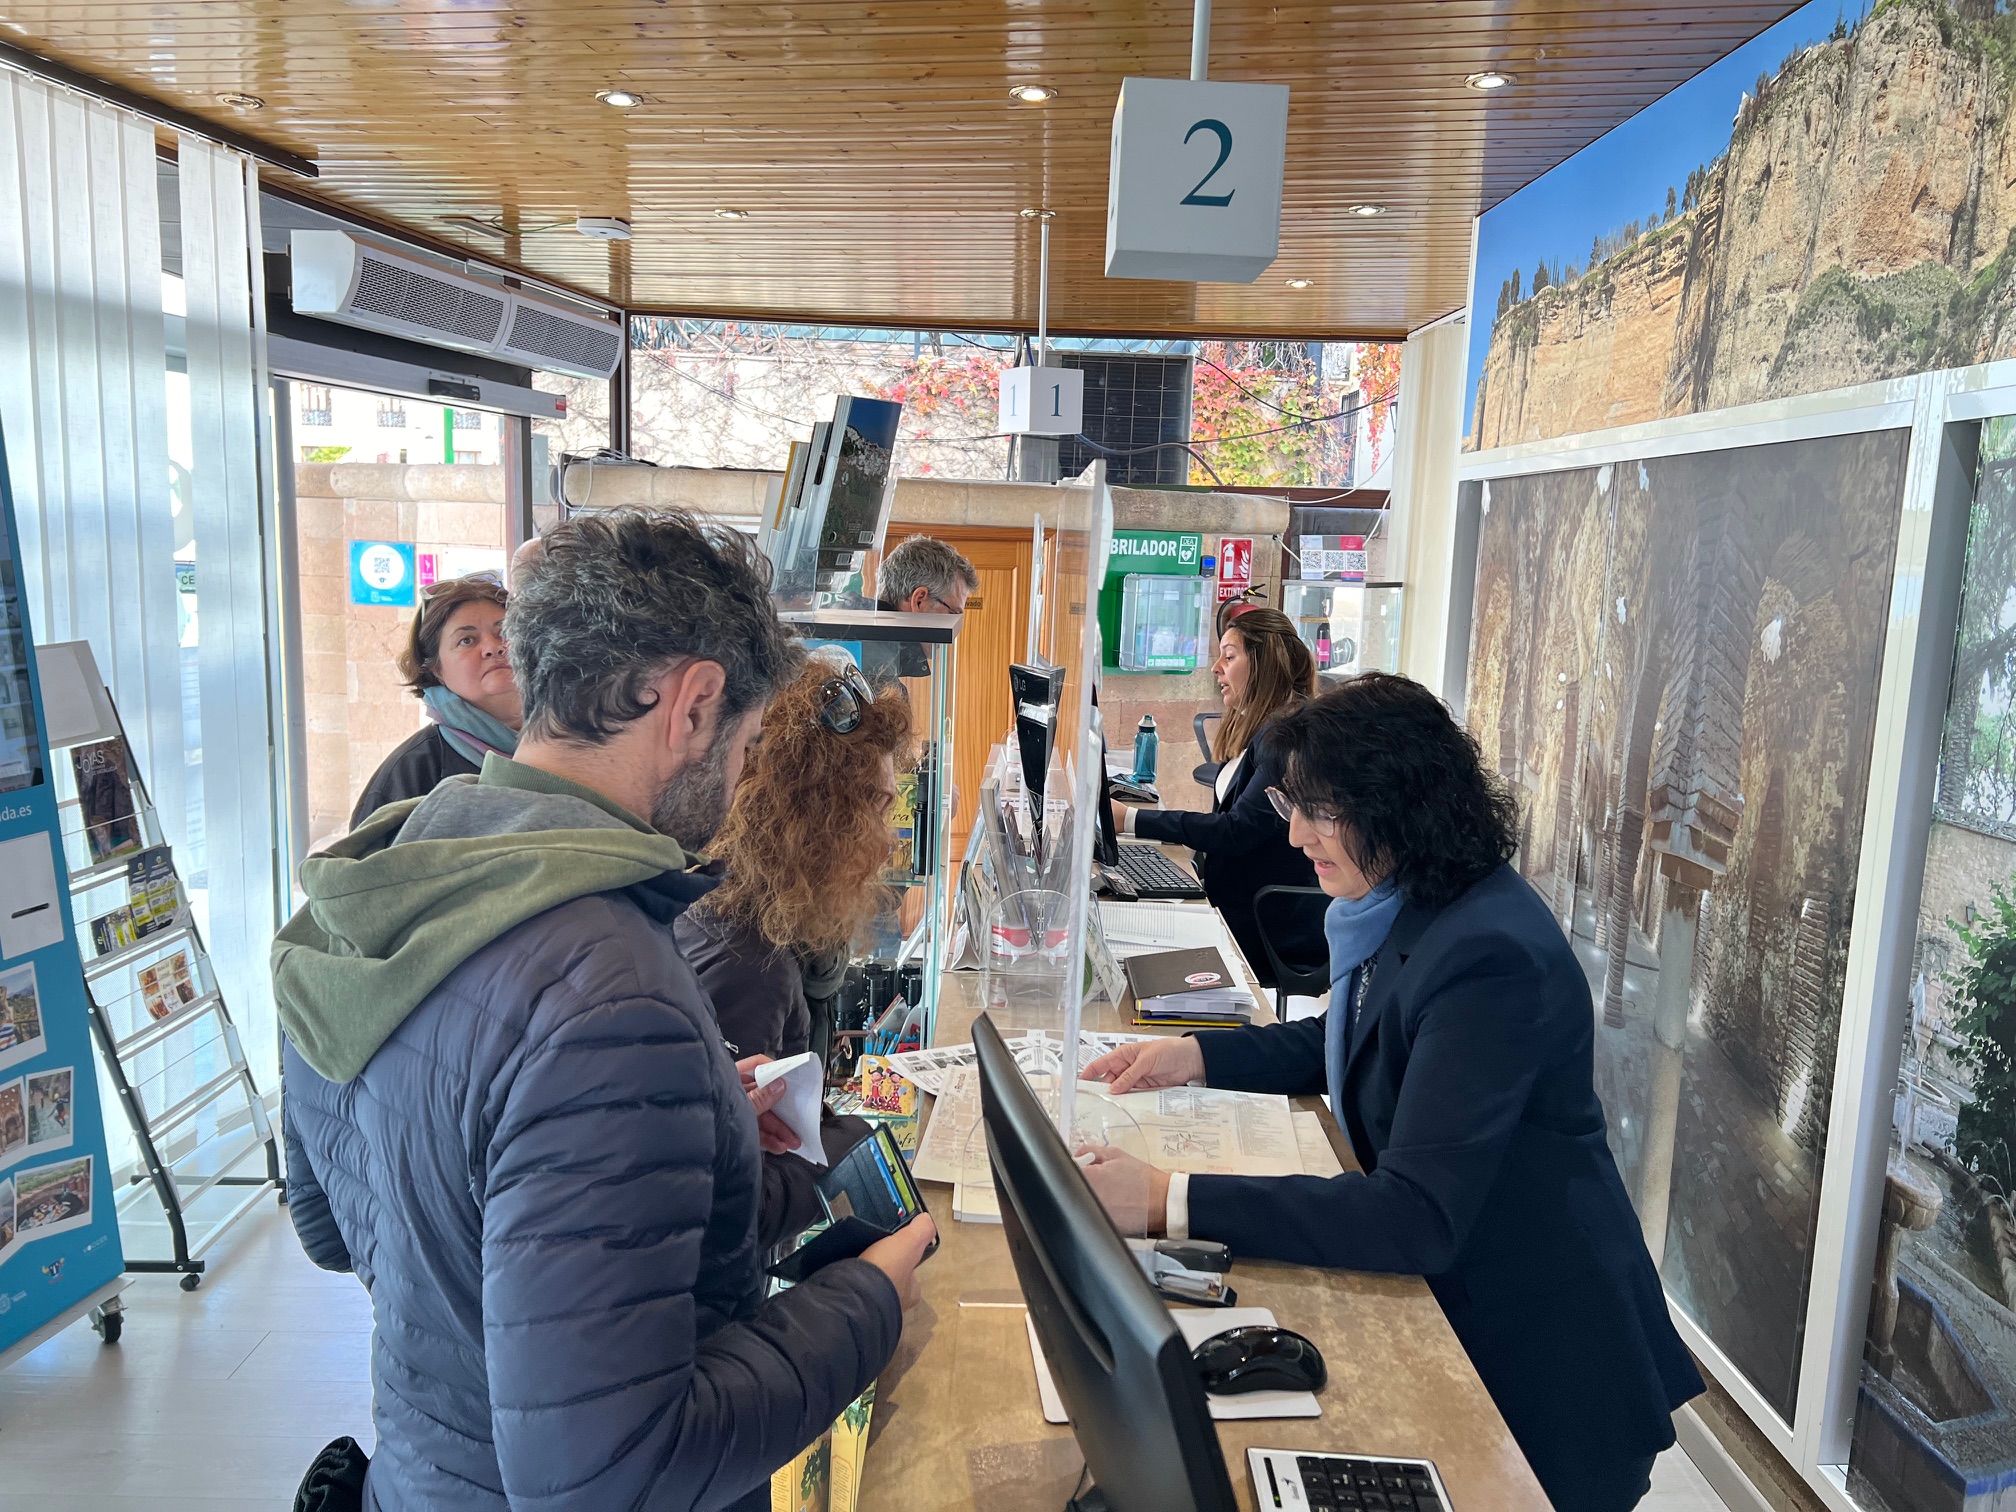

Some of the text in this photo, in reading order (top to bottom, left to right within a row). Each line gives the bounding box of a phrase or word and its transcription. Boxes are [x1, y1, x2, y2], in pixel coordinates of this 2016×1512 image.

[1179, 118, 1236, 207] 2
[1009, 384, 1018, 417] 1
[1050, 383, 1063, 417] 1
[1109, 538, 1177, 557] BRILADOR
[1219, 587, 1248, 598] EXTINTO
[1019, 679, 1027, 691] LG
[76, 750, 105, 773] JOYAS
[0, 805, 32, 821] da.es
